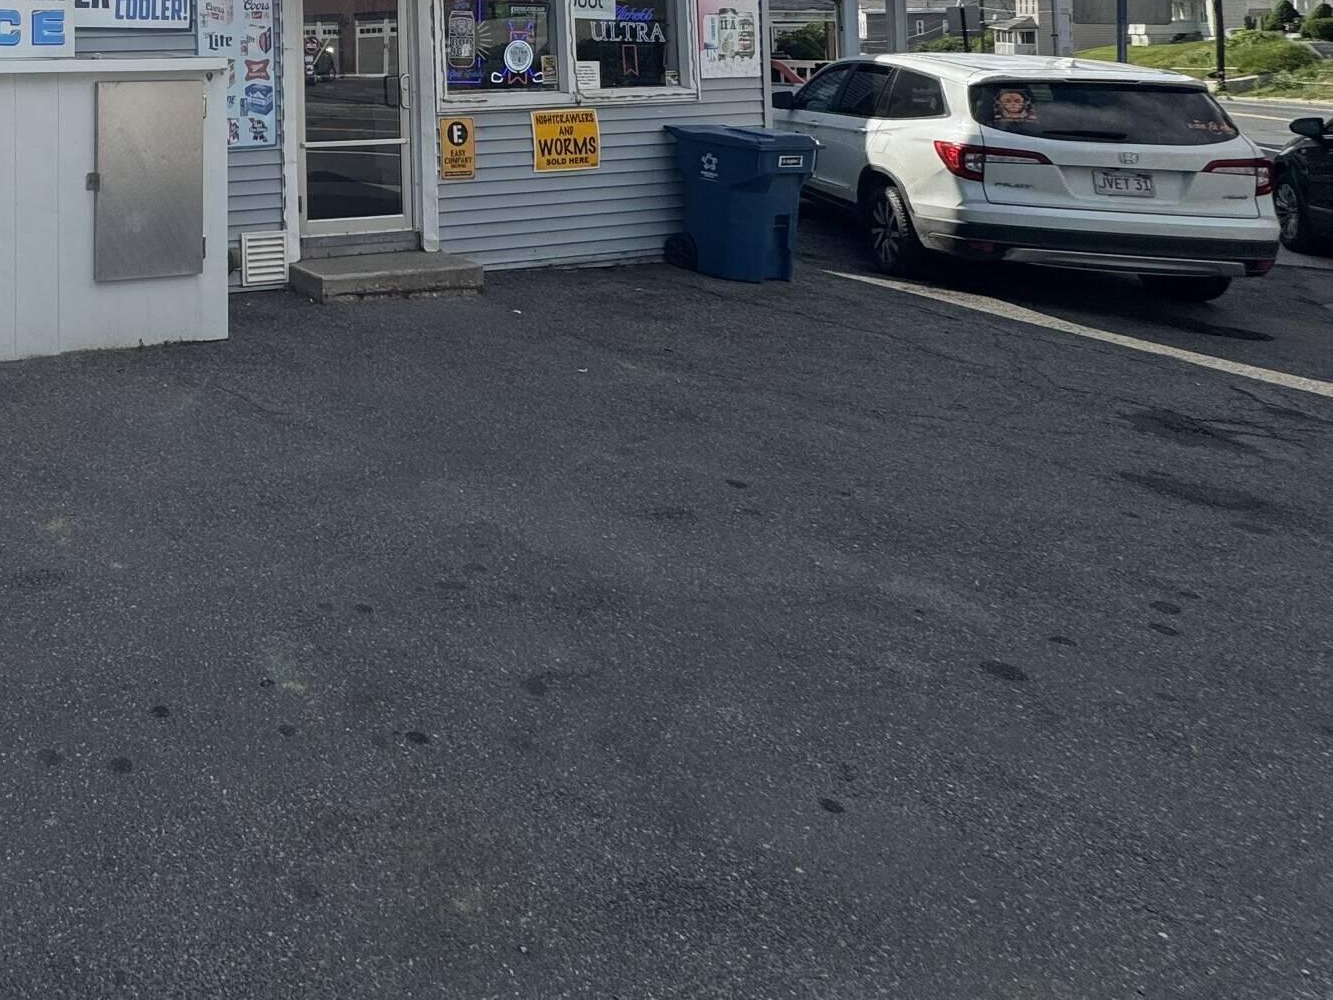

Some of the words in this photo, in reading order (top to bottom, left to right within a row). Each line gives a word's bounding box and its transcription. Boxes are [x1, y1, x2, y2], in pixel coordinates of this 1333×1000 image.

[589, 21, 667, 42] ULTRA
[208, 34, 233, 51] Lite
[535, 112, 595, 125] NIGHTCRAWLERS
[452, 124, 463, 143] E
[558, 126, 574, 136] AND
[538, 136, 596, 157] WORMS
[546, 158, 567, 166] SOLD
[568, 156, 589, 164] HERE
